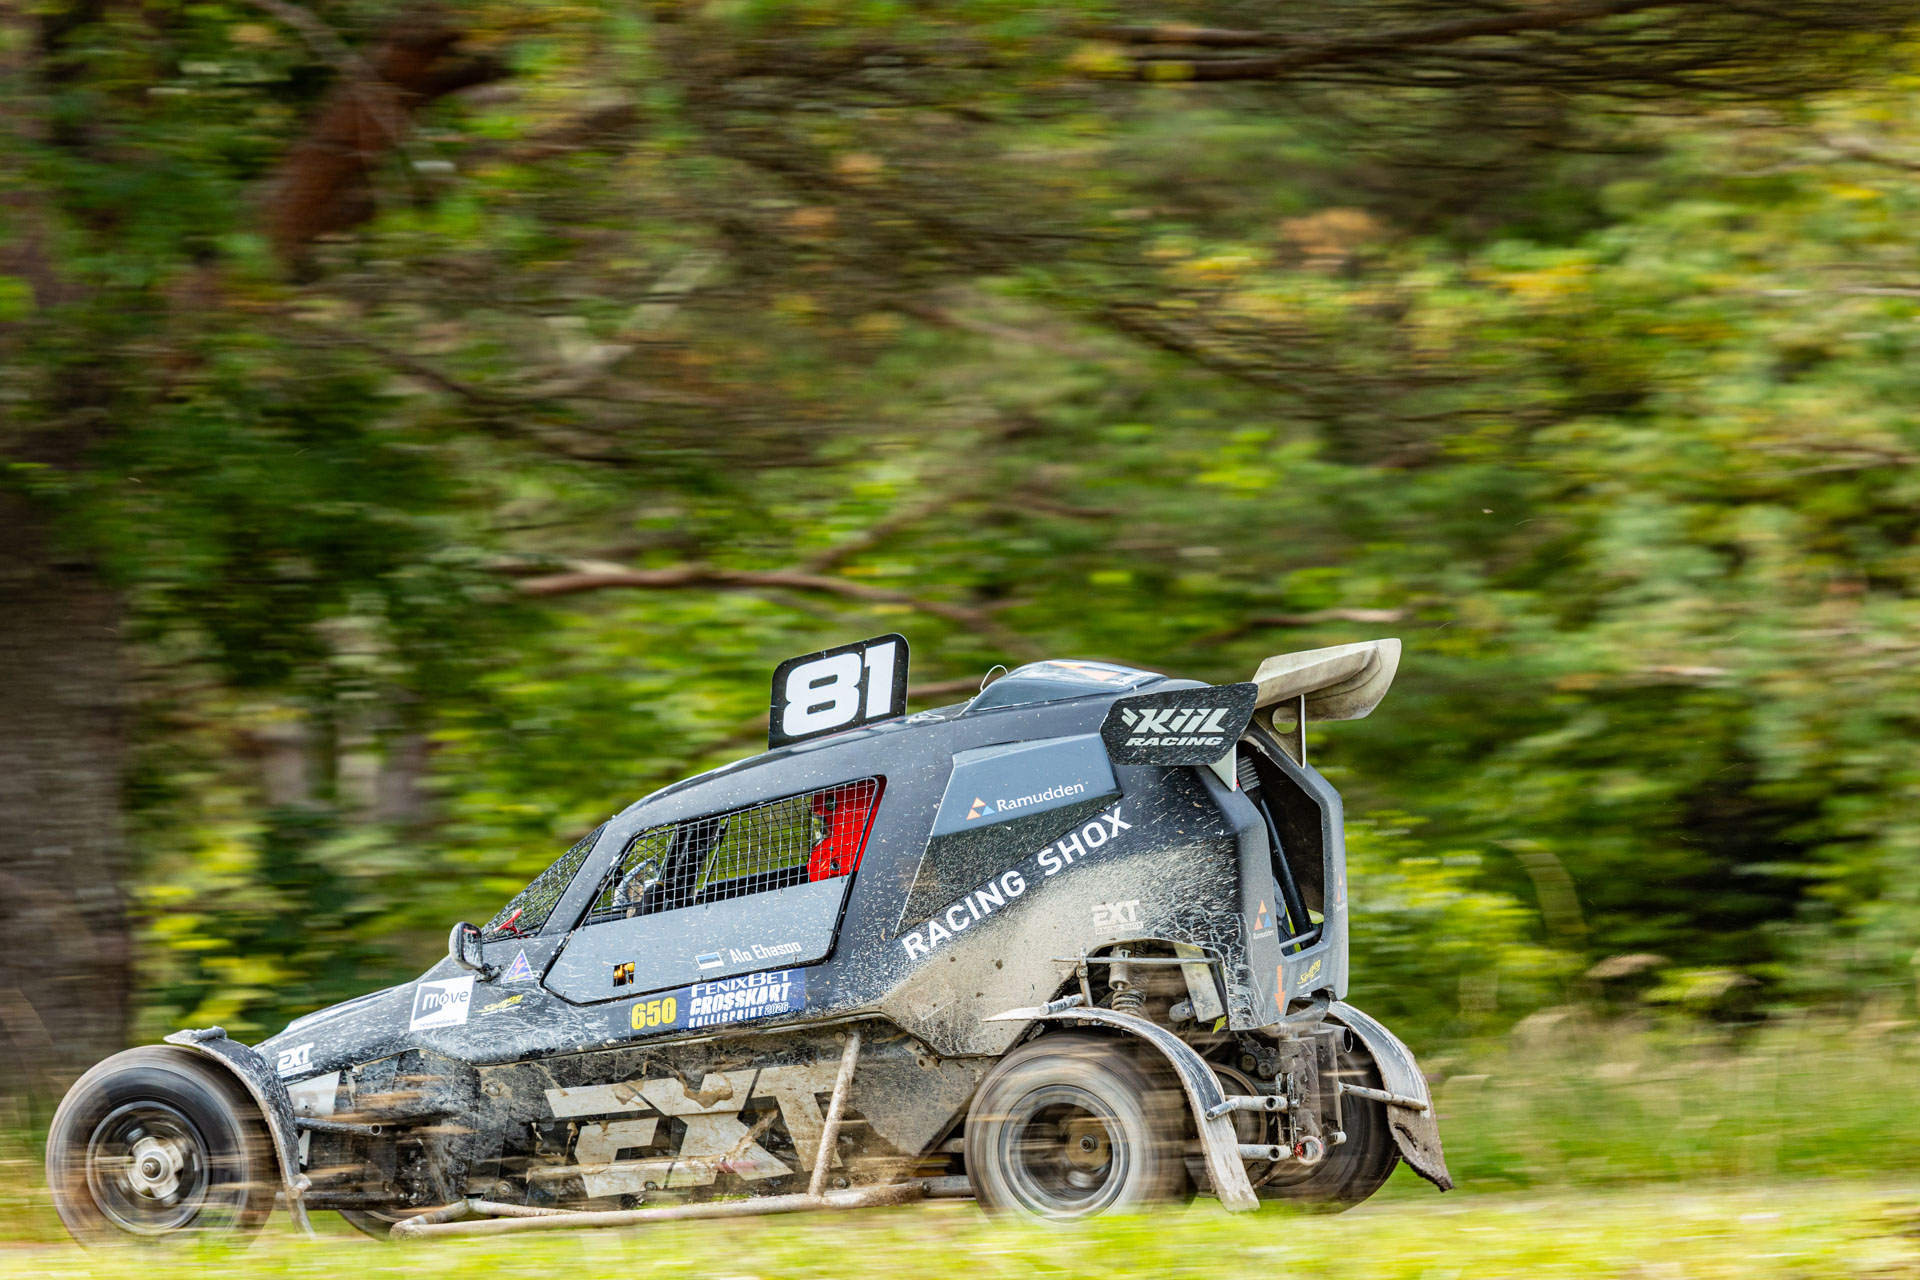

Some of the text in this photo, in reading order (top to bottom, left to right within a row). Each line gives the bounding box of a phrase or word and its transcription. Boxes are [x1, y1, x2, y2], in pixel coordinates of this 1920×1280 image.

[783, 641, 896, 737] 81
[1125, 737, 1224, 747] RACING
[996, 782, 1085, 812] Ramudden
[901, 806, 1133, 961] RACING SHOX
[729, 941, 803, 964] Alo Ehasoo
[422, 990, 469, 1011] move
[631, 997, 677, 1030] 650
[689, 982, 792, 1016] CROSSKART
[688, 1007, 764, 1029] RALLISPRINT
